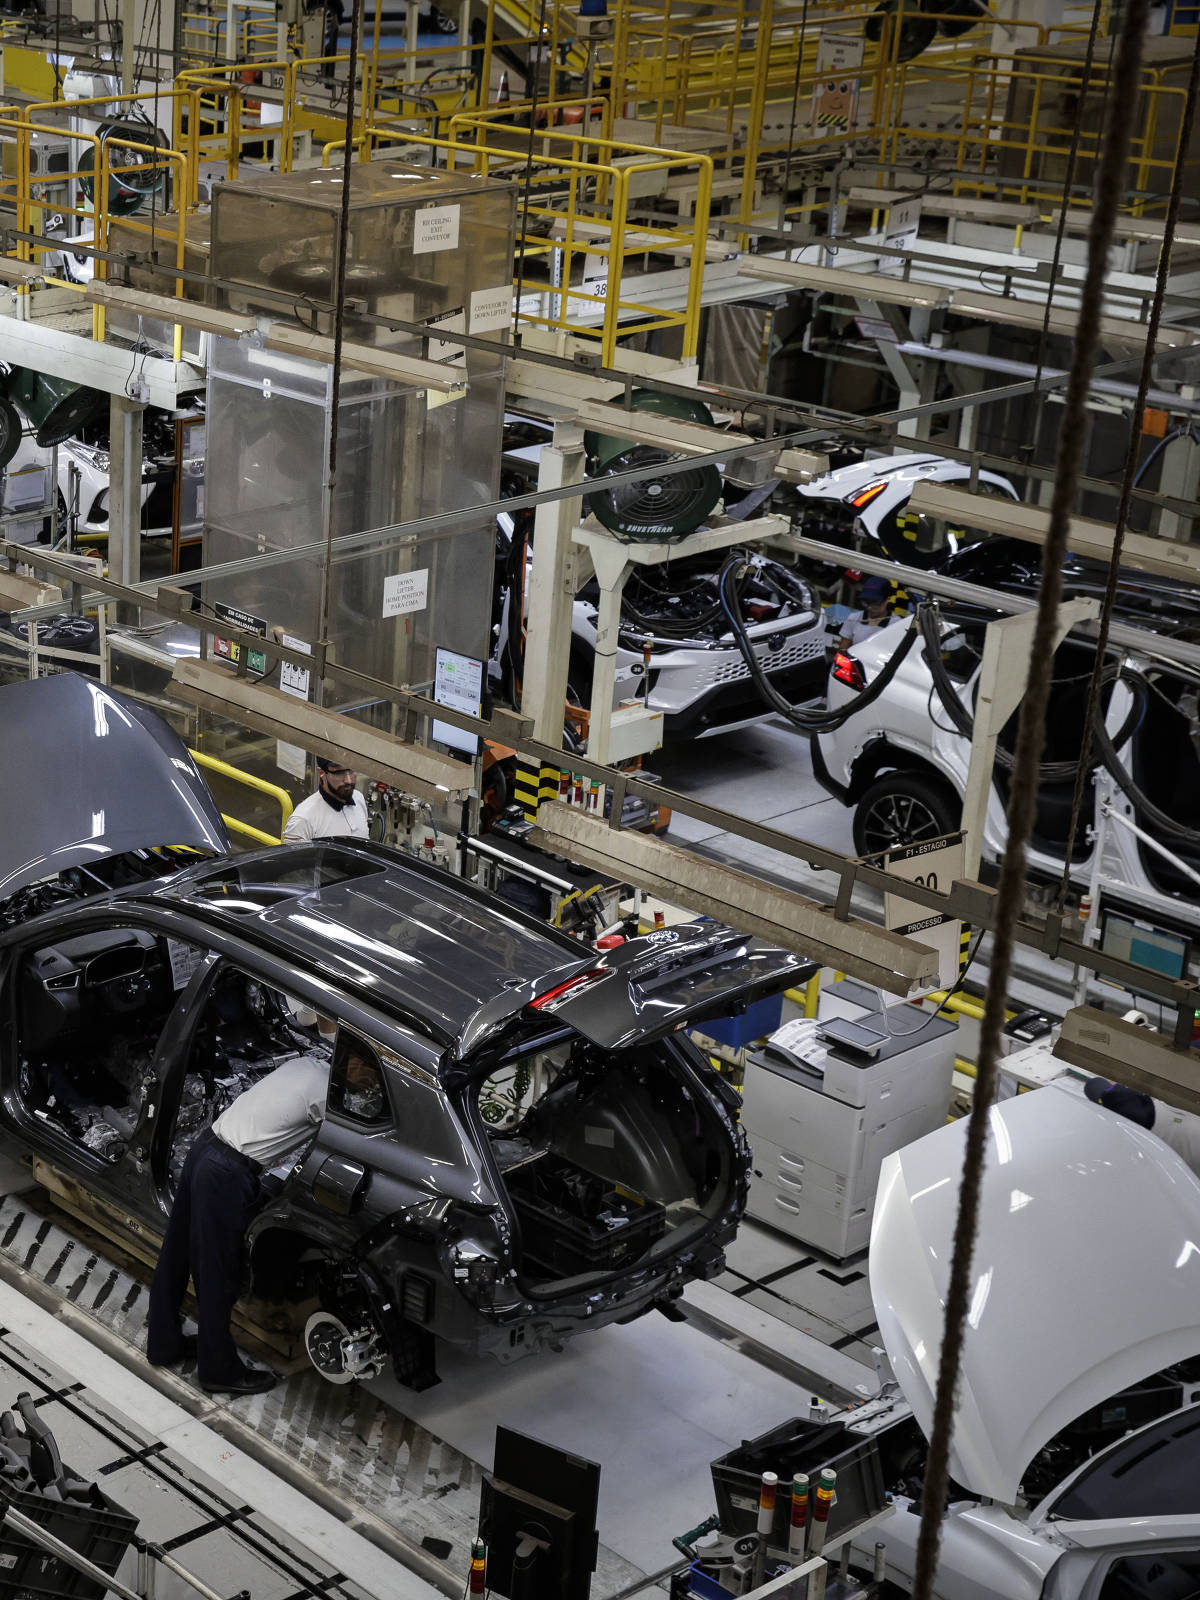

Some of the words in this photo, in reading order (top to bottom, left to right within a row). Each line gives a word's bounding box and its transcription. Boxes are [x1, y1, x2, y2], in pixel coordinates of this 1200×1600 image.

[421, 233, 451, 241] CONVEYOR
[593, 283, 607, 297] 38
[474, 302, 499, 312] CONVEYOR
[474, 312, 489, 320] DOWN
[490, 308, 507, 317] LIFTER
[397, 578, 415, 587] DOWN
[385, 595, 401, 604] HOME
[401, 591, 425, 601] POSITION
[390, 602, 405, 611] PARA
[405, 599, 419, 608] CIMA
[235, 611, 248, 621] CASO
[247, 616, 254, 624] DE
[906, 848, 915, 858] F1
[919, 839, 947, 854] ESTAGIO
[907, 916, 943, 933] PROCESSO
